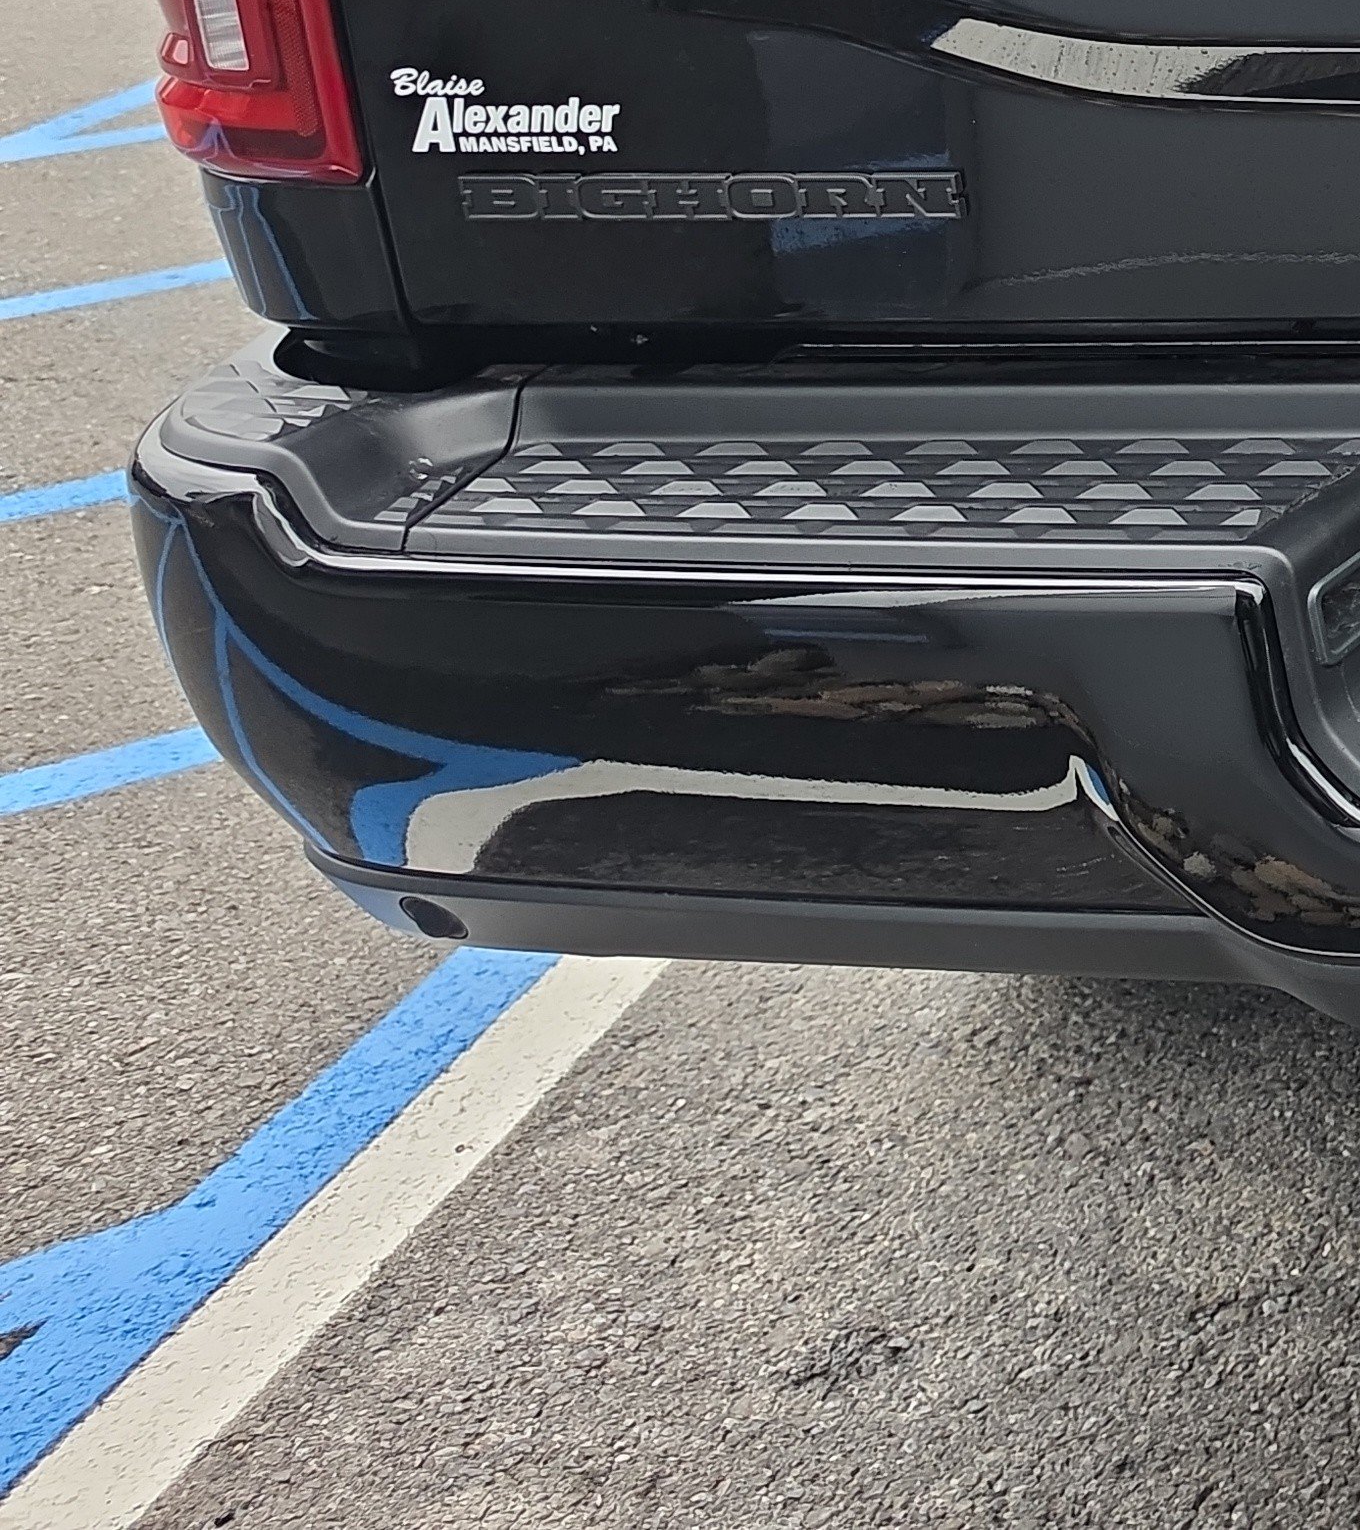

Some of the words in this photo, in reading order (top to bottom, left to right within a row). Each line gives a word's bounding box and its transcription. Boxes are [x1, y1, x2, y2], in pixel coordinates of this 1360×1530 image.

[390, 67, 485, 96] Blaise
[412, 97, 621, 153] Alexander
[459, 136, 584, 155] MANSFIELD,
[588, 135, 618, 153] PA
[457, 172, 967, 220] BIGHORN
